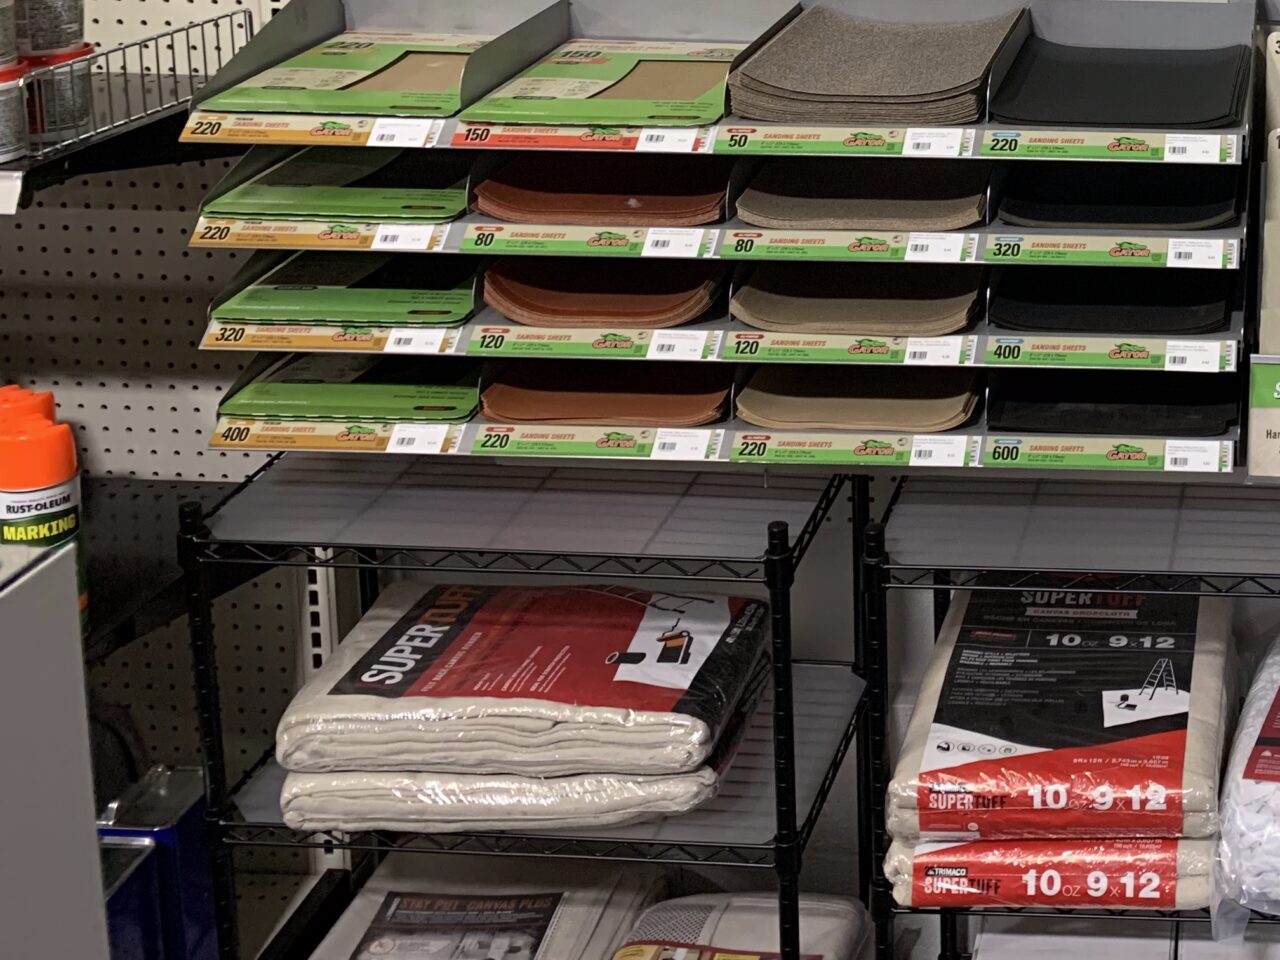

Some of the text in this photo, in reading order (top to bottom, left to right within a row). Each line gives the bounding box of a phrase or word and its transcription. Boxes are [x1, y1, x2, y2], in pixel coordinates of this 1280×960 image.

[191, 121, 222, 136] 220
[464, 128, 491, 142] 150
[581, 129, 623, 141] GATOR
[728, 134, 748, 149] 50
[990, 138, 1018, 152] 220
[200, 226, 231, 240] 220
[473, 232, 494, 248] 80
[735, 239, 754, 253] 80
[993, 243, 1021, 257] 320
[215, 326, 245, 342] 320
[479, 334, 504, 349] 120
[734, 340, 759, 355] 120
[994, 344, 1021, 360] 400
[221, 427, 250, 442] 400
[481, 434, 509, 449] 220
[738, 442, 767, 457] 220
[992, 446, 1020, 461] 600
[6, 493, 71, 514] RUST-OLEUM
[3, 513, 76, 540] MARKING
[935, 868, 967, 876] TRIMACO
[1022, 869, 1061, 897] 10
[1087, 871, 1109, 897] 9
[1120, 873, 1160, 898] 12
